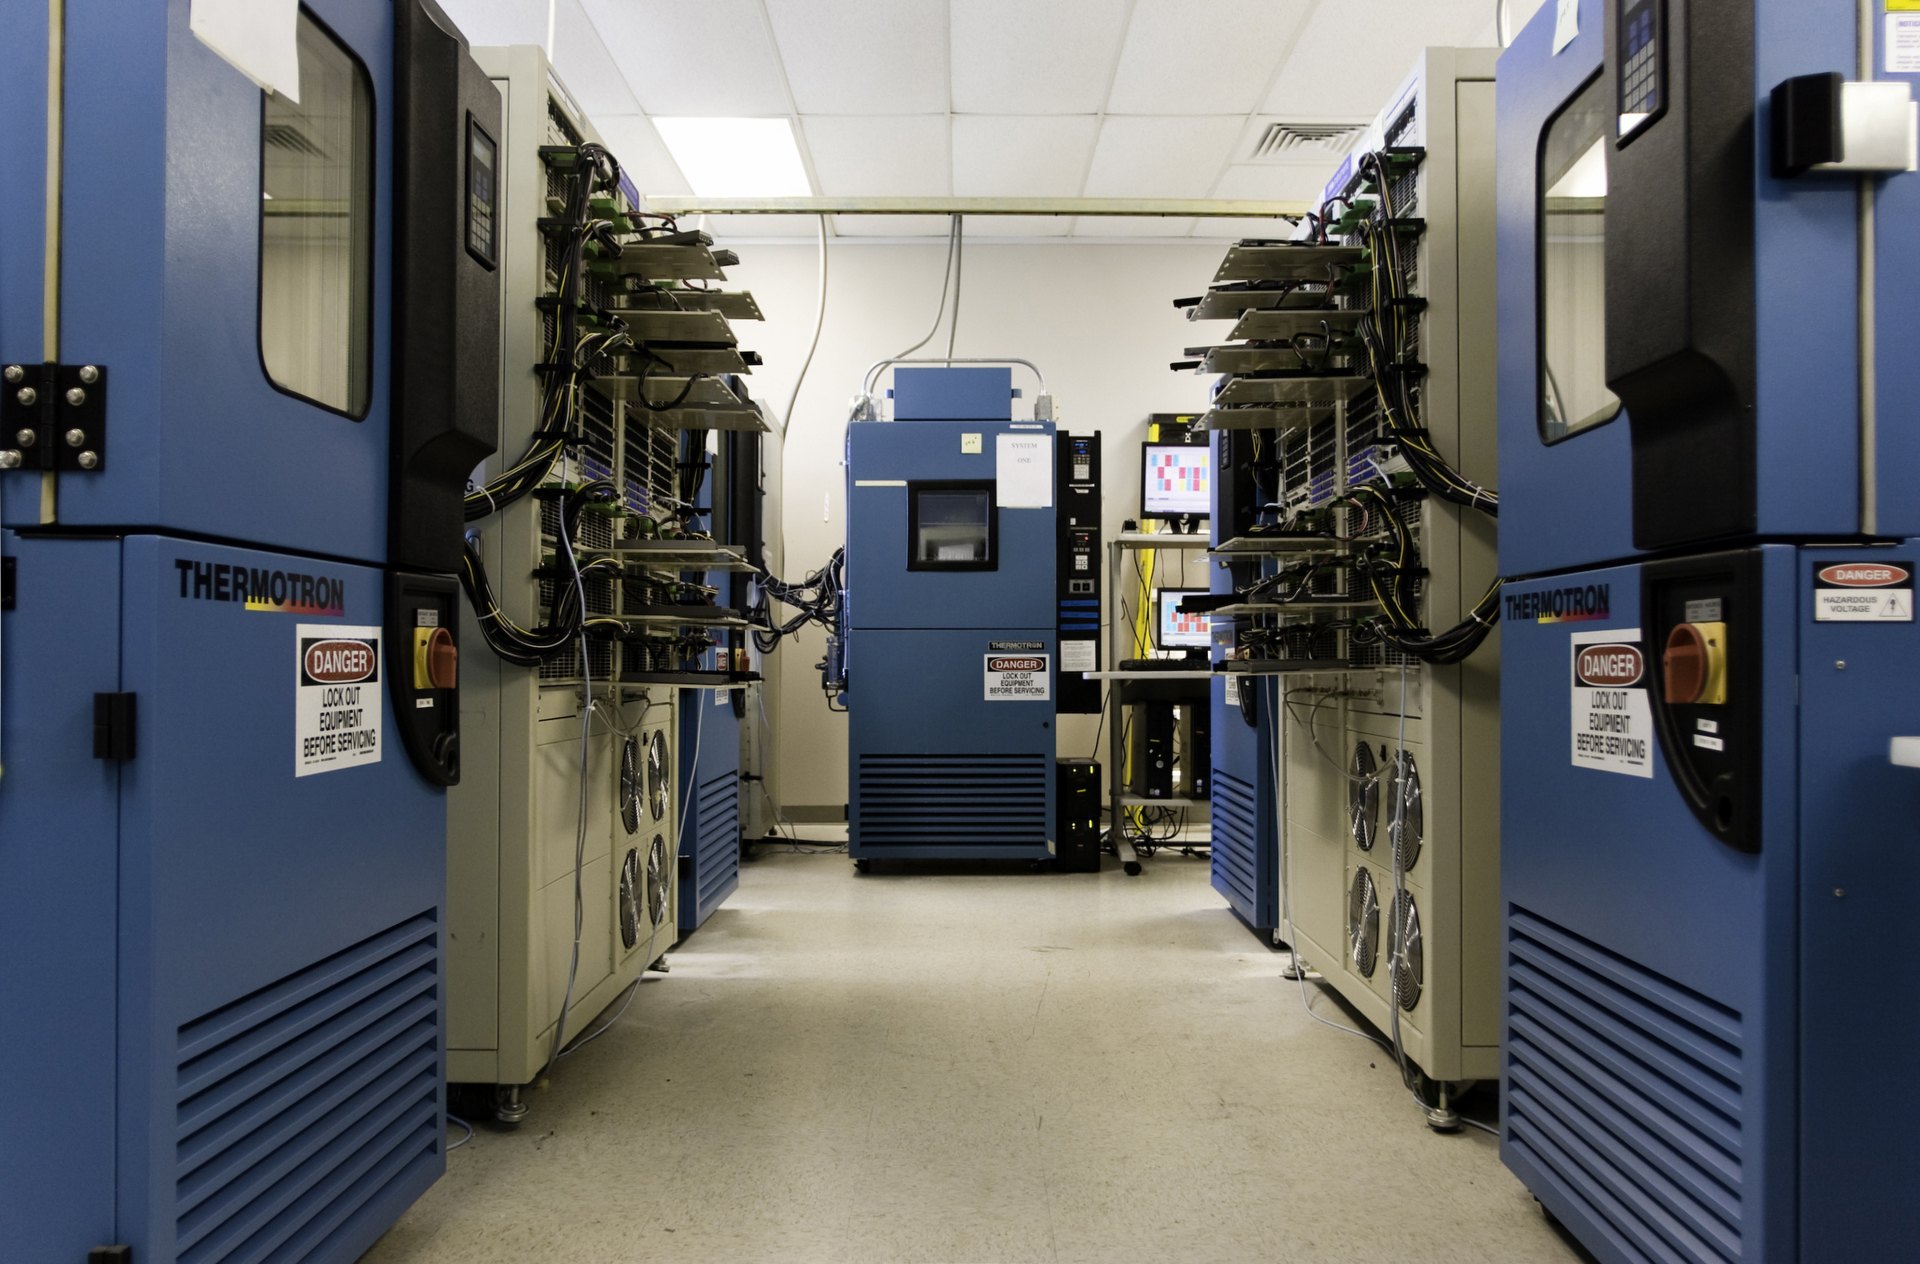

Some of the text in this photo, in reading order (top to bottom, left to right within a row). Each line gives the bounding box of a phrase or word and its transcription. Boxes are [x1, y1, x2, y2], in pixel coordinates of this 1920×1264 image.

[175, 559, 344, 609] THERMOTRON
[1836, 570, 1892, 580] DANGER
[1505, 585, 1609, 620] THERMOTRON
[314, 650, 367, 674] DANGER
[996, 660, 1037, 669] DANGER
[1583, 654, 1635, 677] DANGER
[323, 686, 361, 708] LOCK OUT
[1591, 691, 1628, 710] LOCK OUT
[320, 709, 363, 731] EQUIPMENT
[1589, 713, 1631, 734] EQUIPMENT
[304, 729, 376, 757] BEFORE SERVICING
[1577, 733, 1646, 759] BEFORE SERVICING
